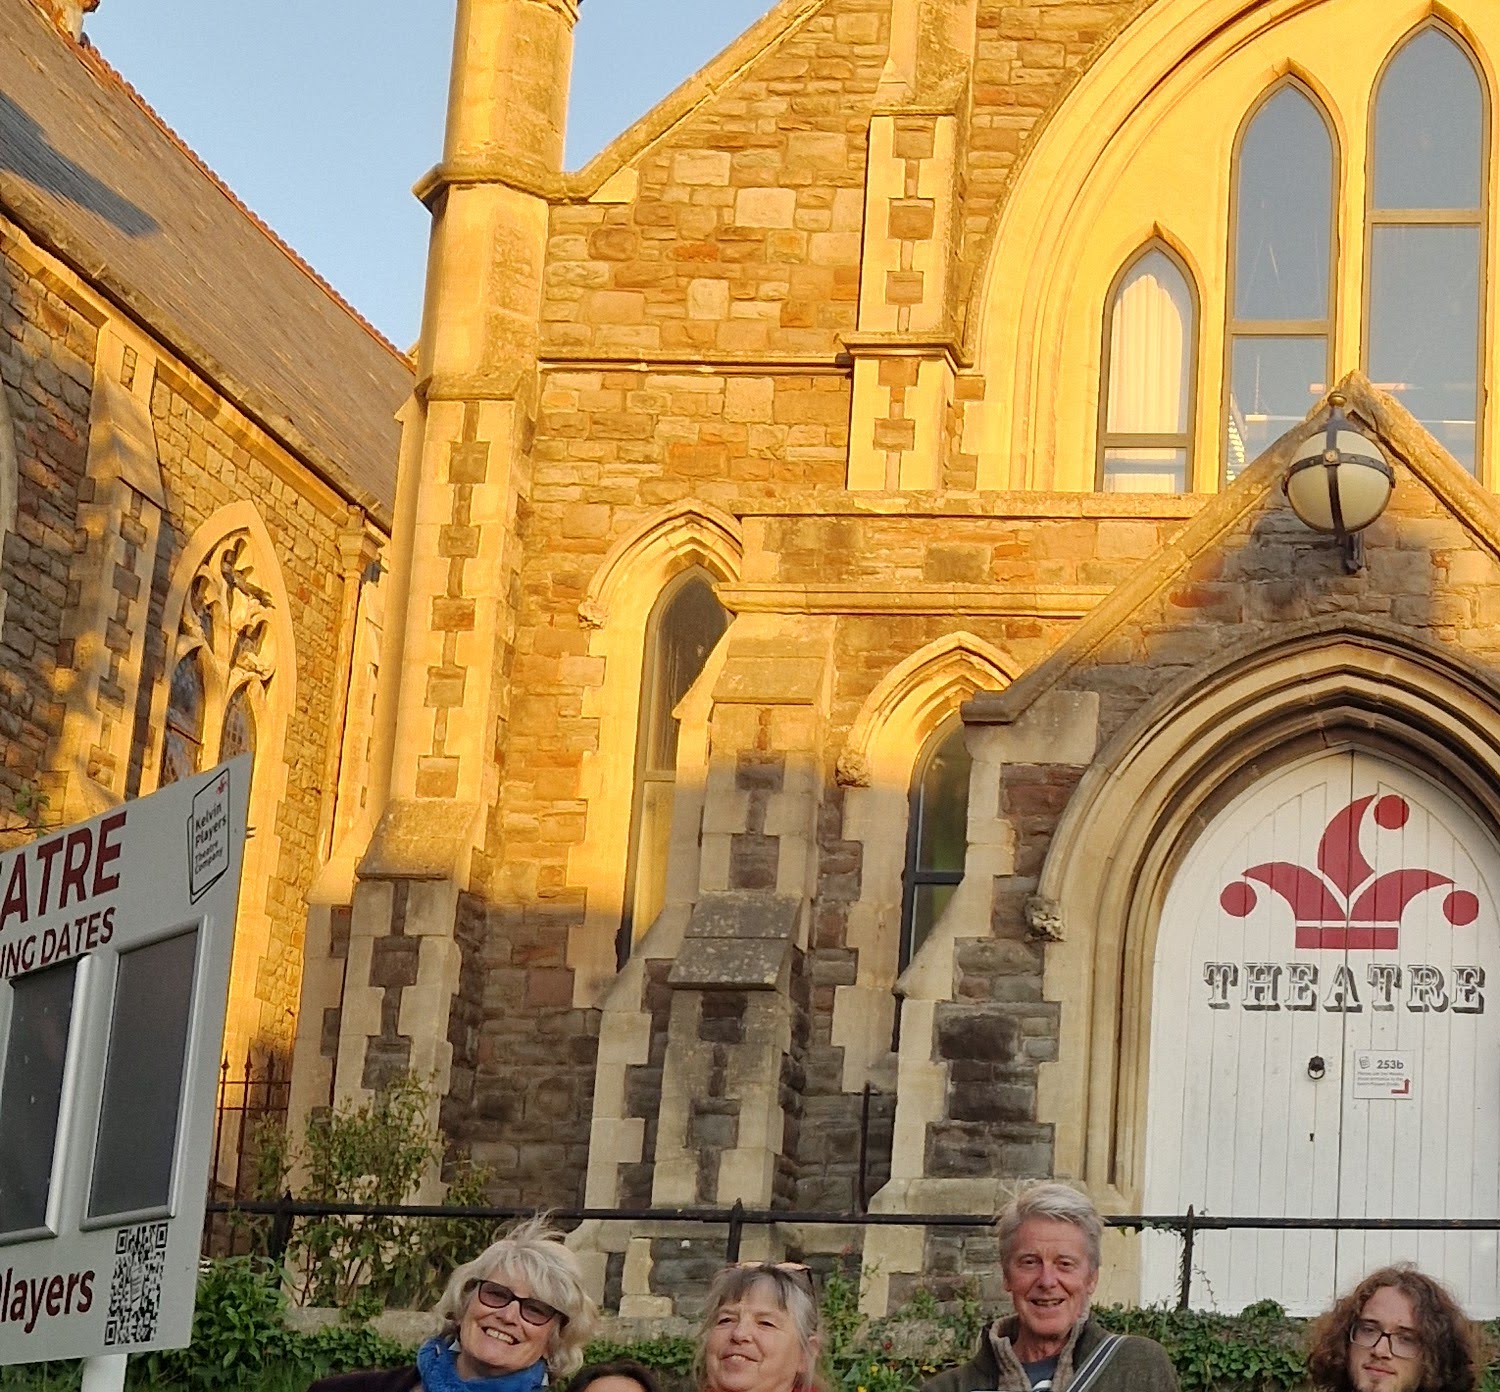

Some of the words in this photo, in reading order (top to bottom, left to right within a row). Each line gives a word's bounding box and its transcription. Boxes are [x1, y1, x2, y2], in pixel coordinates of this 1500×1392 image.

[195, 803, 222, 832] Kelvin
[195, 814, 226, 848] Players
[0, 811, 127, 931] ATRE
[0, 935, 37, 979] ING
[40, 907, 117, 965] DATES
[1203, 961, 1486, 1014] THEATRE
[1376, 1059, 1404, 1069] 253b
[0, 1267, 96, 1334] layers
